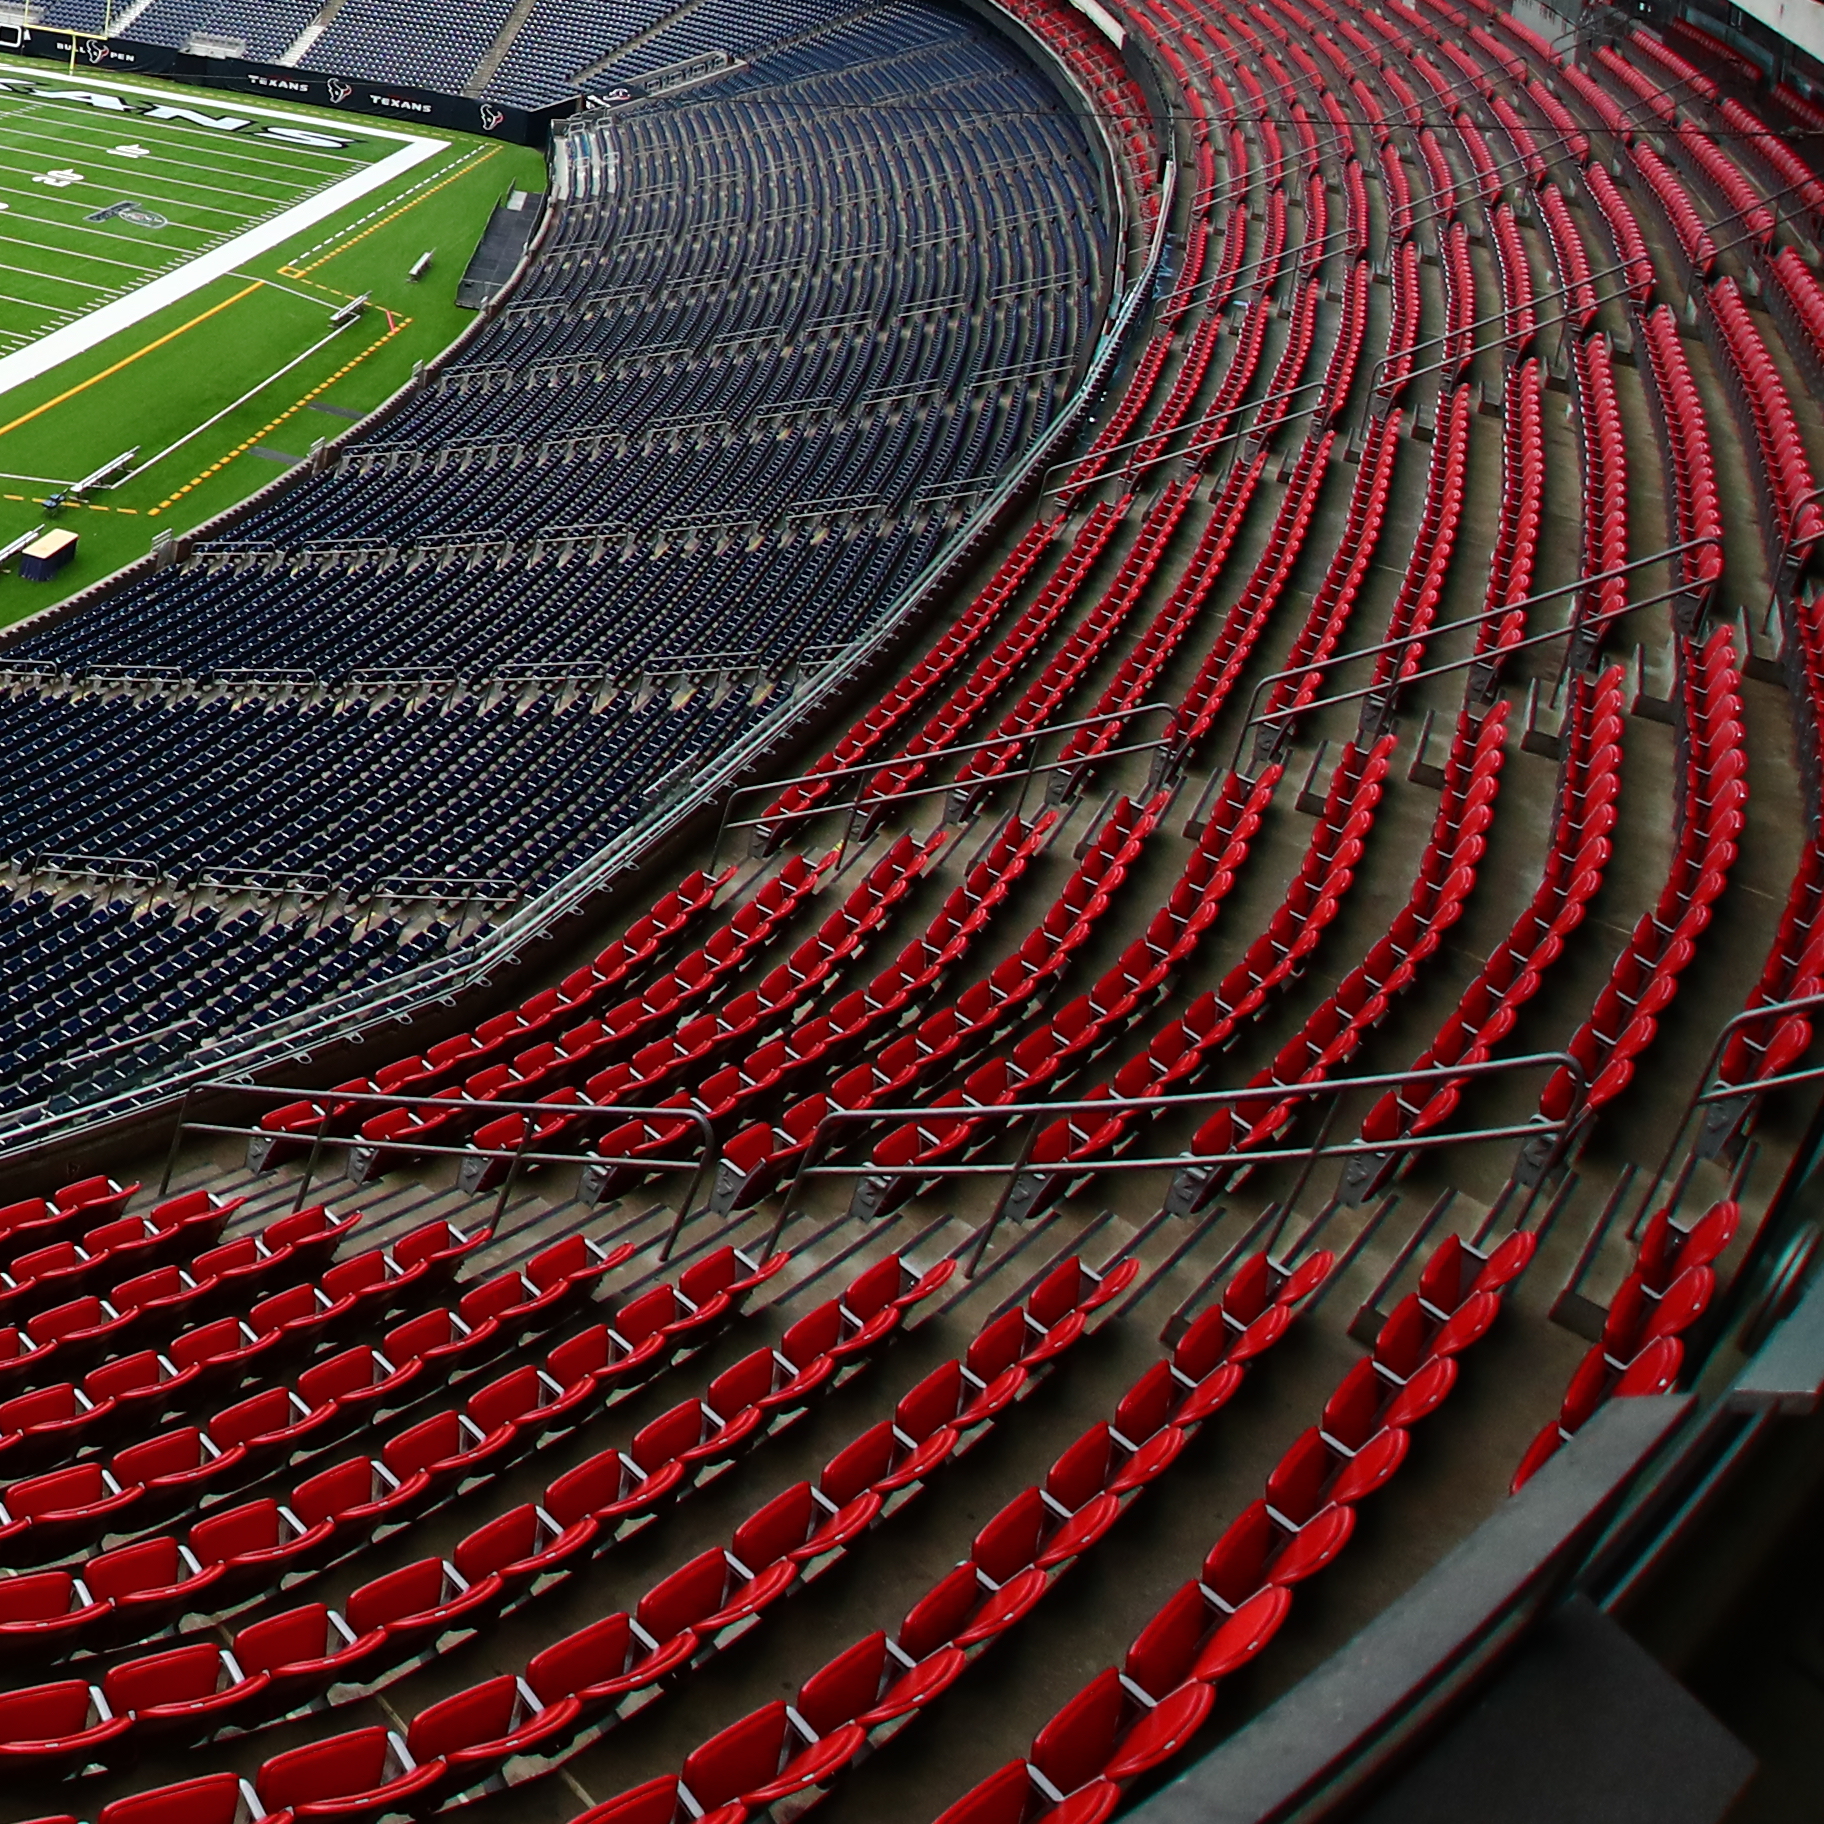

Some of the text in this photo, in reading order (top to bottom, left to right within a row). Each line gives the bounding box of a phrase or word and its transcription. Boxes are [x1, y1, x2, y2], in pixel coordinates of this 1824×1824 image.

[110, 51, 135, 62] PEN
[248, 74, 310, 92] TEXANS
[370, 94, 432, 113] TEXANS
